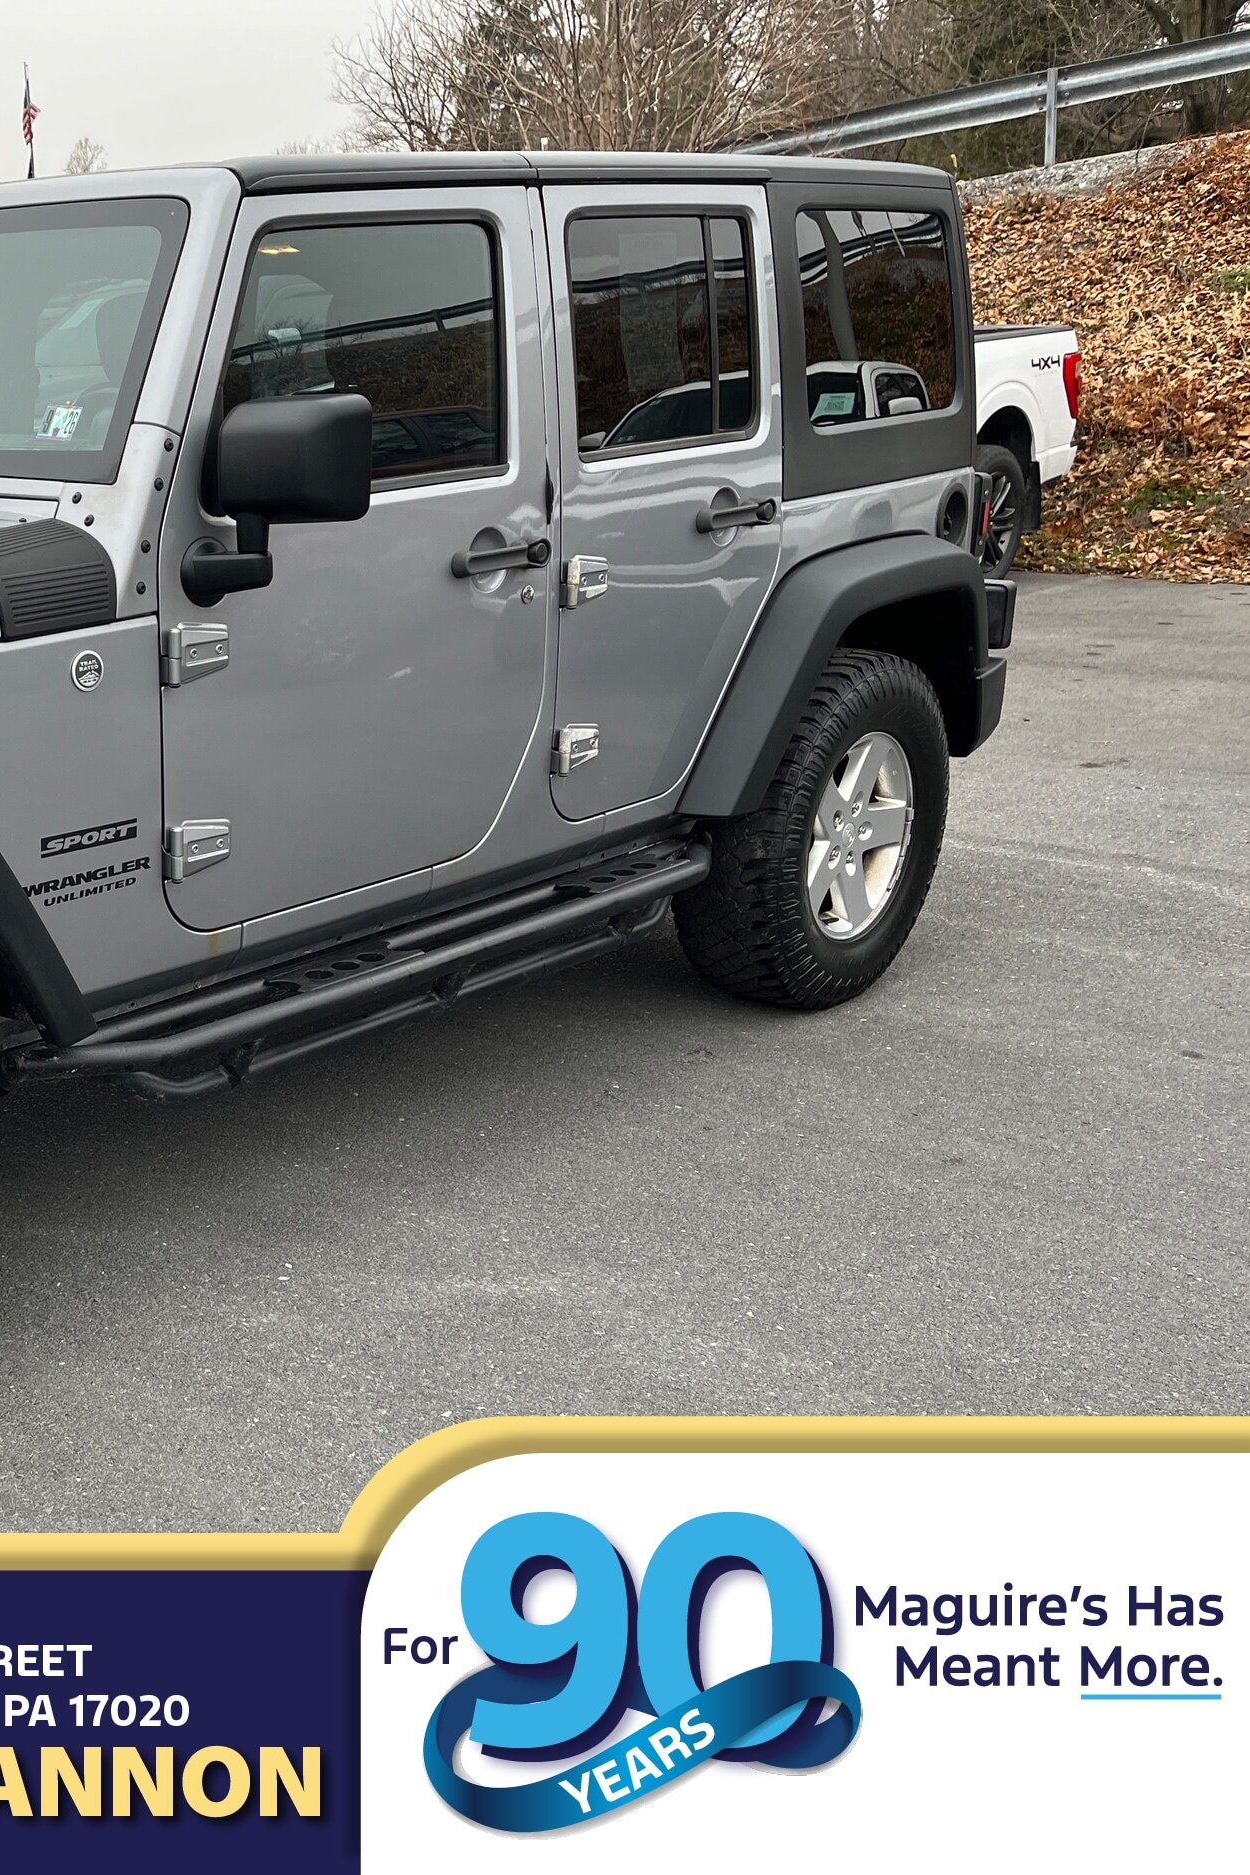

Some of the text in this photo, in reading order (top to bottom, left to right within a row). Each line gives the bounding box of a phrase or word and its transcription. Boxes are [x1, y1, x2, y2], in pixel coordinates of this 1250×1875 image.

[44, 823, 136, 854] SPORT
[22, 857, 151, 898] WRANGLER
[43, 877, 137, 907] UNLIMITED
